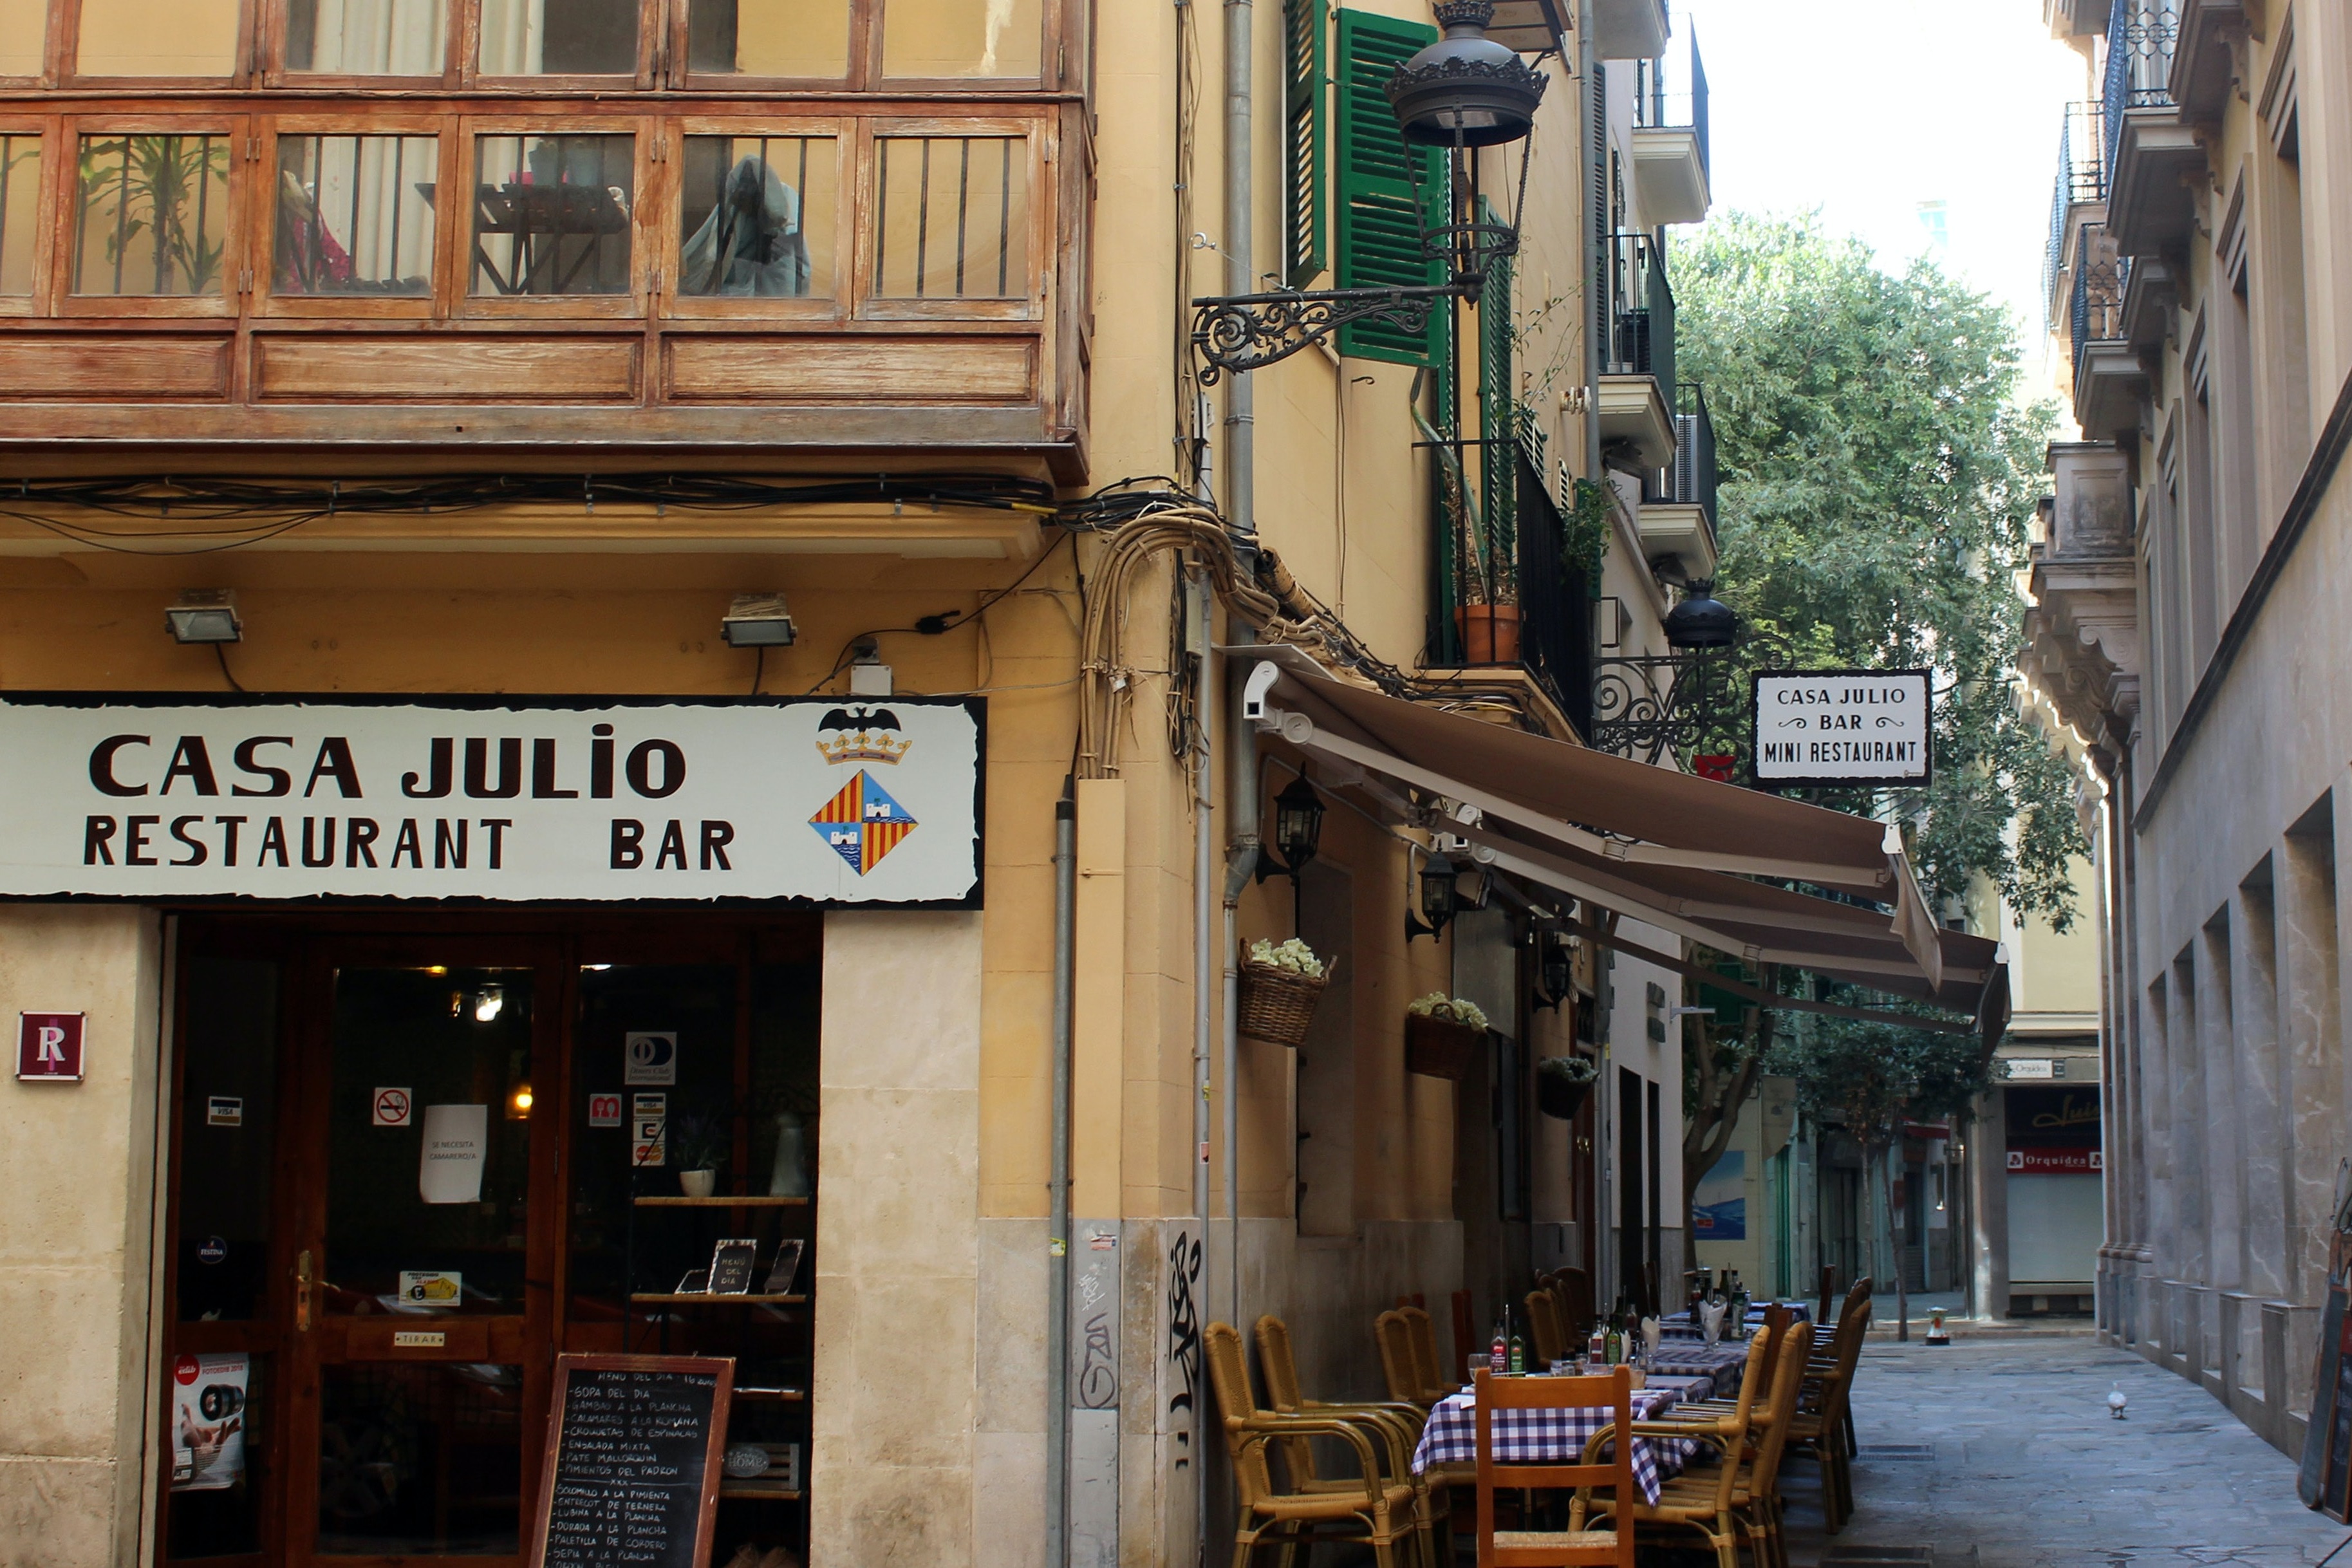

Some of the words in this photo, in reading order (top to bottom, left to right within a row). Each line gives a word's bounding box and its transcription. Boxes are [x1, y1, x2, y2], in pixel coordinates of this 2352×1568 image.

[1777, 689, 1831, 705] CASA
[1839, 689, 1905, 704] JULIO
[1820, 714, 1862, 730] BAR
[1764, 742, 1801, 762] MINI
[1810, 742, 1917, 762] RESTAURANT
[88, 734, 364, 799] CASA
[83, 815, 514, 870] RESTAURANT
[610, 819, 735, 872] BAR
[36, 1026, 66, 1061] R
[403, 1335, 436, 1343] TIRAR
[597, 1372, 626, 1381] MENU
[633, 1373, 651, 1381] DEL
[608, 1388, 626, 1398] DEL
[633, 1388, 651, 1399] DIA
[617, 1402, 626, 1412] A
[630, 1403, 642, 1412] LA
[631, 1427, 642, 1437] DE
[617, 1466, 636, 1477] DEL
[601, 1489, 610, 1498] A
[613, 1489, 624, 1498] LA
[607, 1500, 620, 1510] DE
[595, 1509, 604, 1519] A
[606, 1510, 618, 1520] LA
[595, 1524, 603, 1534] A
[608, 1524, 619, 1534] LA
[606, 1536, 620, 1547] DE
[586, 1549, 594, 1559] A
[600, 1550, 611, 1560] LA
